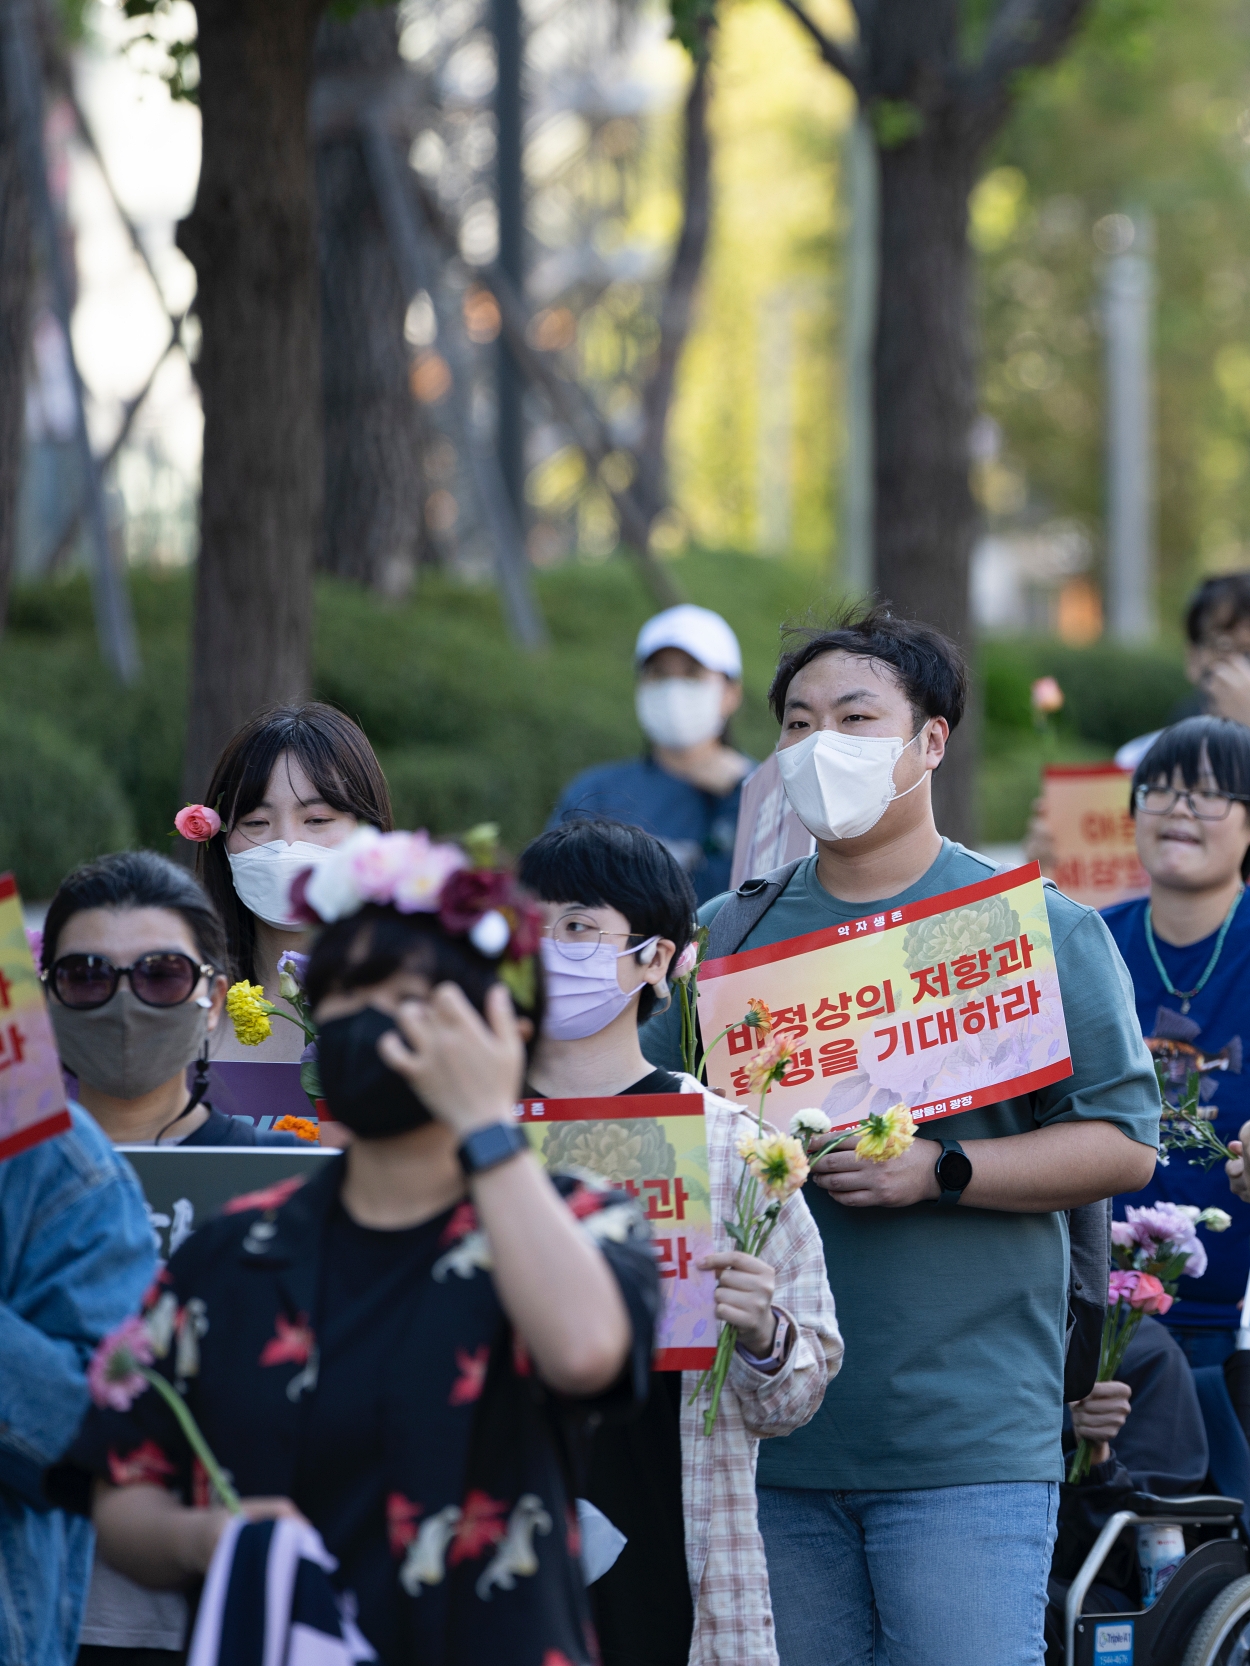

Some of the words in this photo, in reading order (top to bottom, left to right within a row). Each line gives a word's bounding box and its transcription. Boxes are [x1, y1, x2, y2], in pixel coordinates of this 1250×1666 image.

[909, 934, 1033, 1004] 저항과
[874, 979, 1042, 1062] 기대하라
[949, 1095, 973, 1110] 광장
